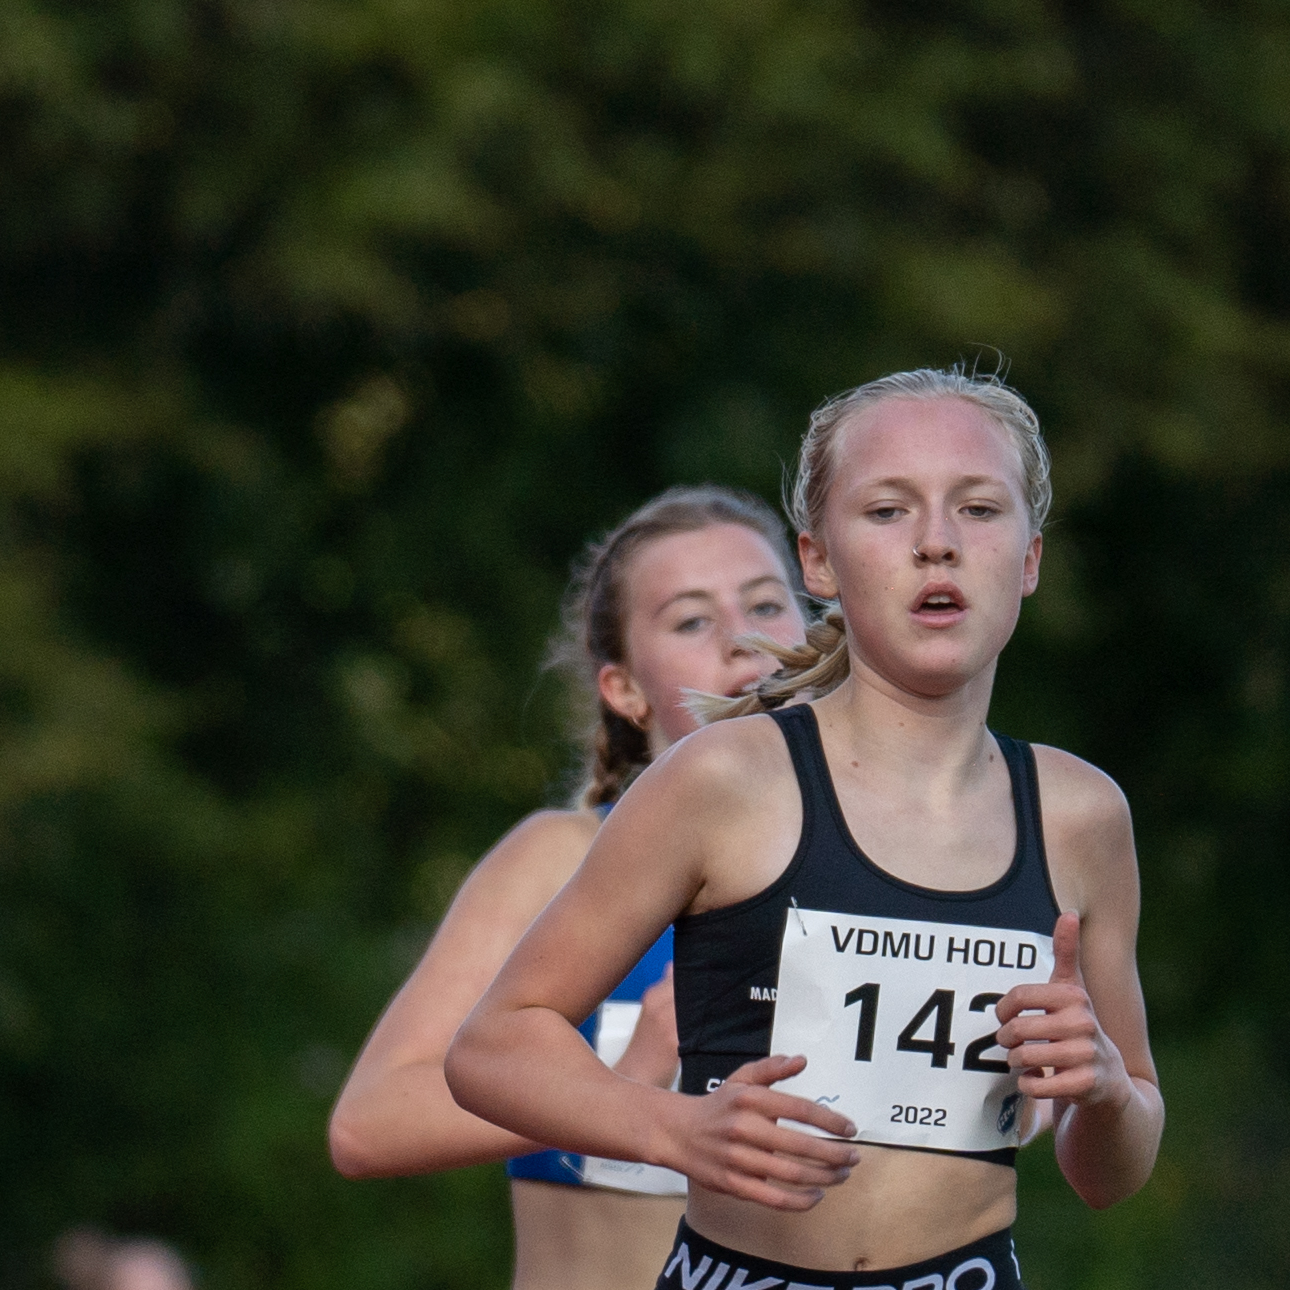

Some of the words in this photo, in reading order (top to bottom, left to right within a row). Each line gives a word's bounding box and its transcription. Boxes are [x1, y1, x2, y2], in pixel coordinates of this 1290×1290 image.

[831, 925, 934, 961] VDMU
[947, 936, 1037, 971] HOLD
[843, 981, 1010, 1074] 142
[890, 1104, 948, 1128] 2022
